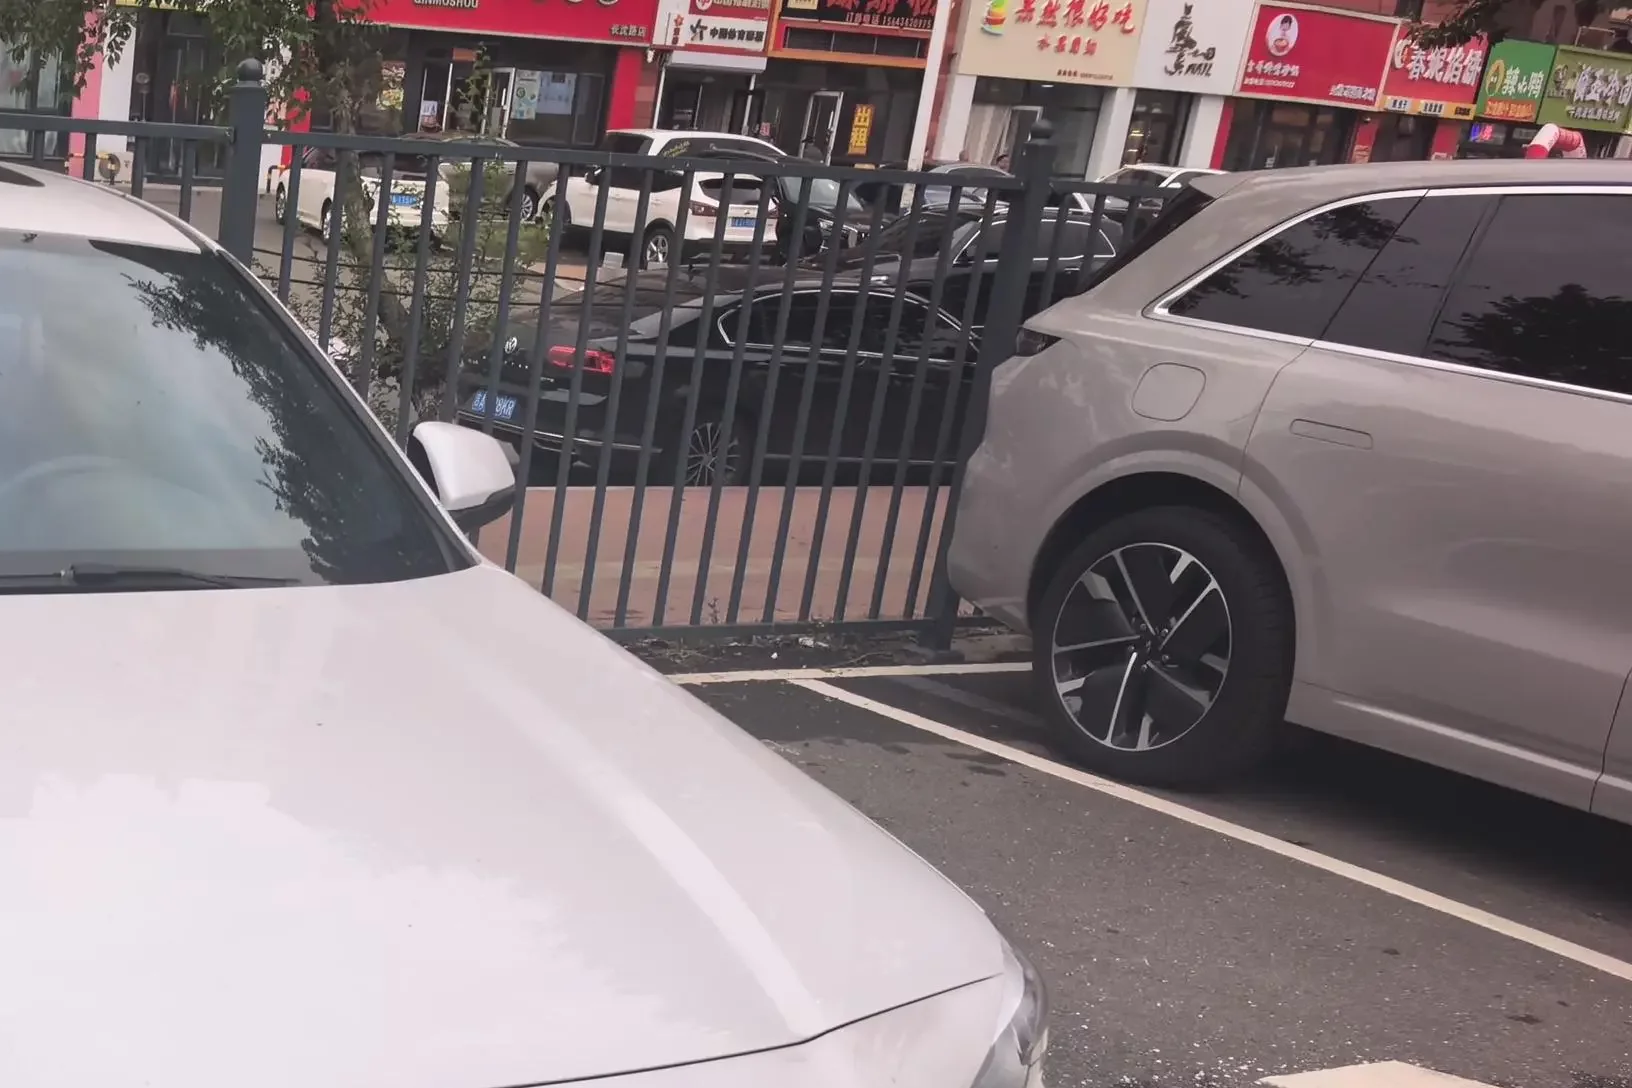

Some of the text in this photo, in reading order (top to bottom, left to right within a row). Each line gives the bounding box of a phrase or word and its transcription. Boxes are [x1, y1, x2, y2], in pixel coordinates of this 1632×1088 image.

[709, 26, 765, 42] 中国体育彩票
[850, 105, 872, 149] 出租
